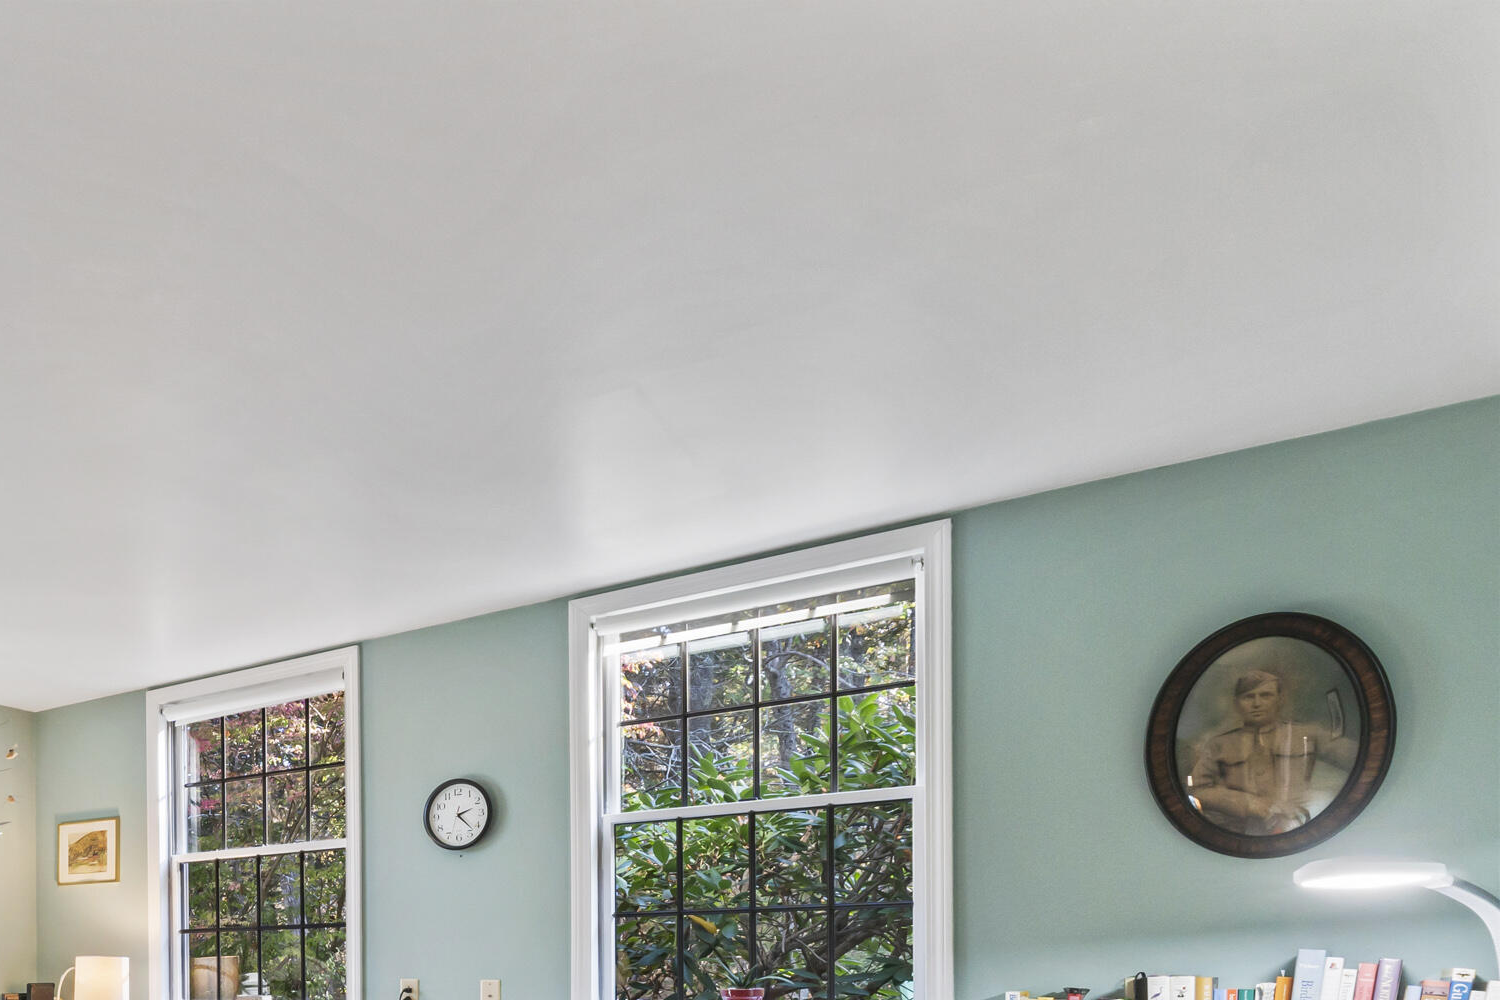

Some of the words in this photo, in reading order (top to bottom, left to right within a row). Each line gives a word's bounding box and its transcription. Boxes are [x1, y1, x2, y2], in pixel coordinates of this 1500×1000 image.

[444, 792, 451, 801] 11
[453, 788, 462, 797] 12
[474, 797, 482, 805] 2
[436, 802, 446, 811] 10
[445, 832, 452, 840] 7
[455, 833, 463, 842] 6
[467, 829, 474, 838] 5
